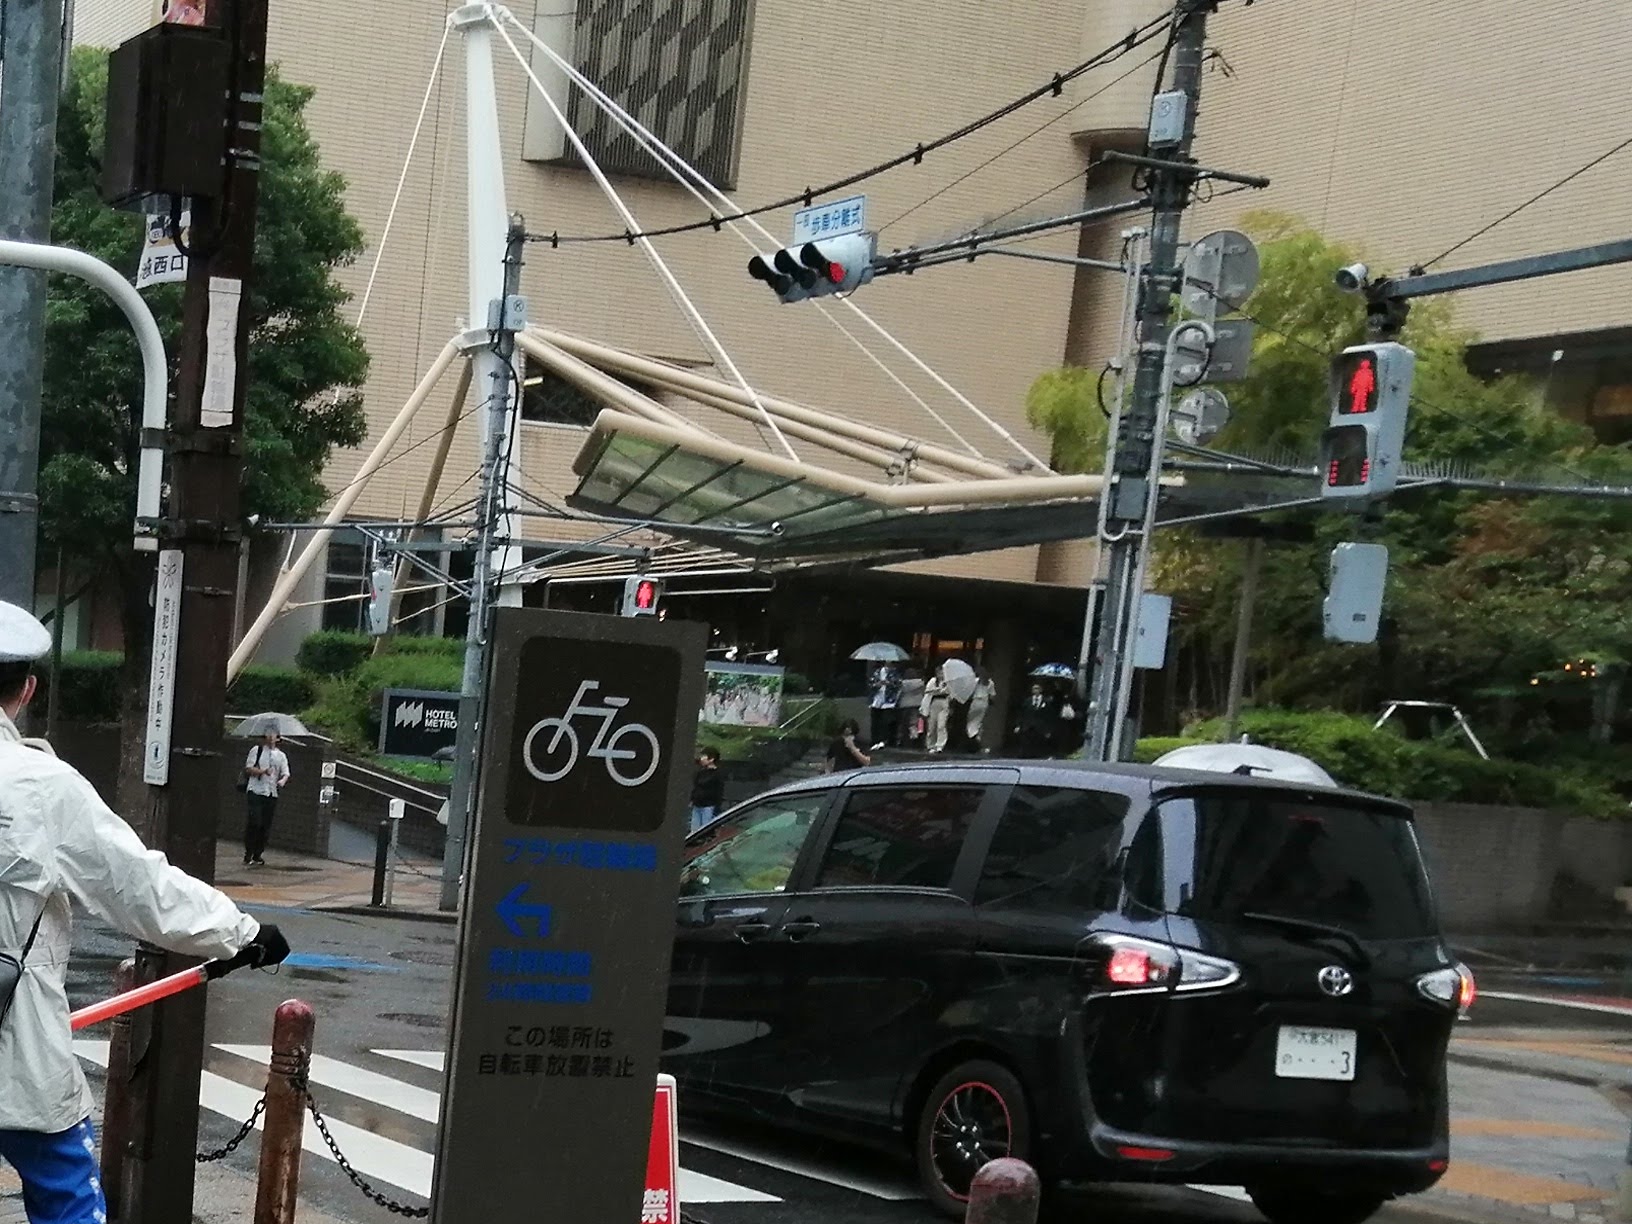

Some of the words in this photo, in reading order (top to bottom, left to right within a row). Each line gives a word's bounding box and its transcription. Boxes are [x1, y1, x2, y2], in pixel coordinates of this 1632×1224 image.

[425, 709, 456, 720] HOTEL
[505, 1025, 615, 1050] この場所は
[477, 1054, 636, 1079] 自転車放置禁止
